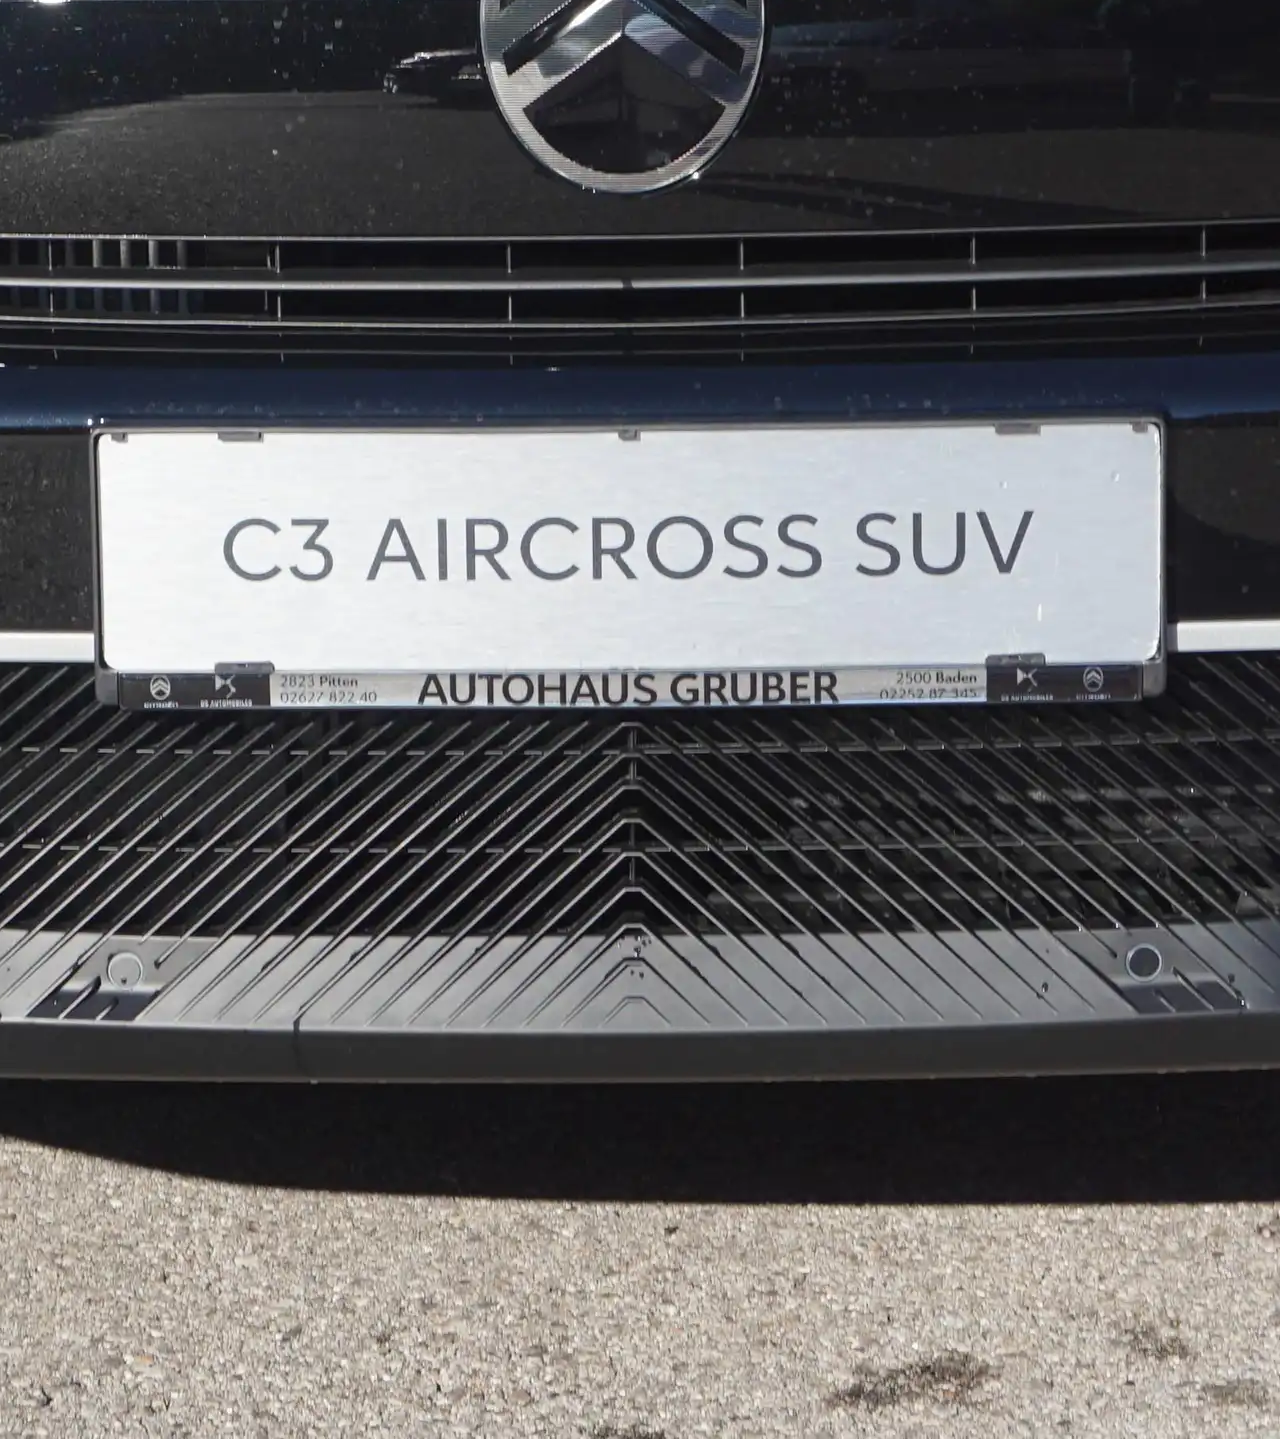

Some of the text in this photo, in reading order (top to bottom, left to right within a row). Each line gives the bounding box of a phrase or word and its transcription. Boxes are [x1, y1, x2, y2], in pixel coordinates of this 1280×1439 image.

[223, 510, 1035, 582] C3 AIRCROSS SUV
[280, 673, 359, 688] 2823 Pitten
[417, 670, 840, 707] AUTOHAUS GRUBER
[896, 668, 978, 685] 2500 Baden
